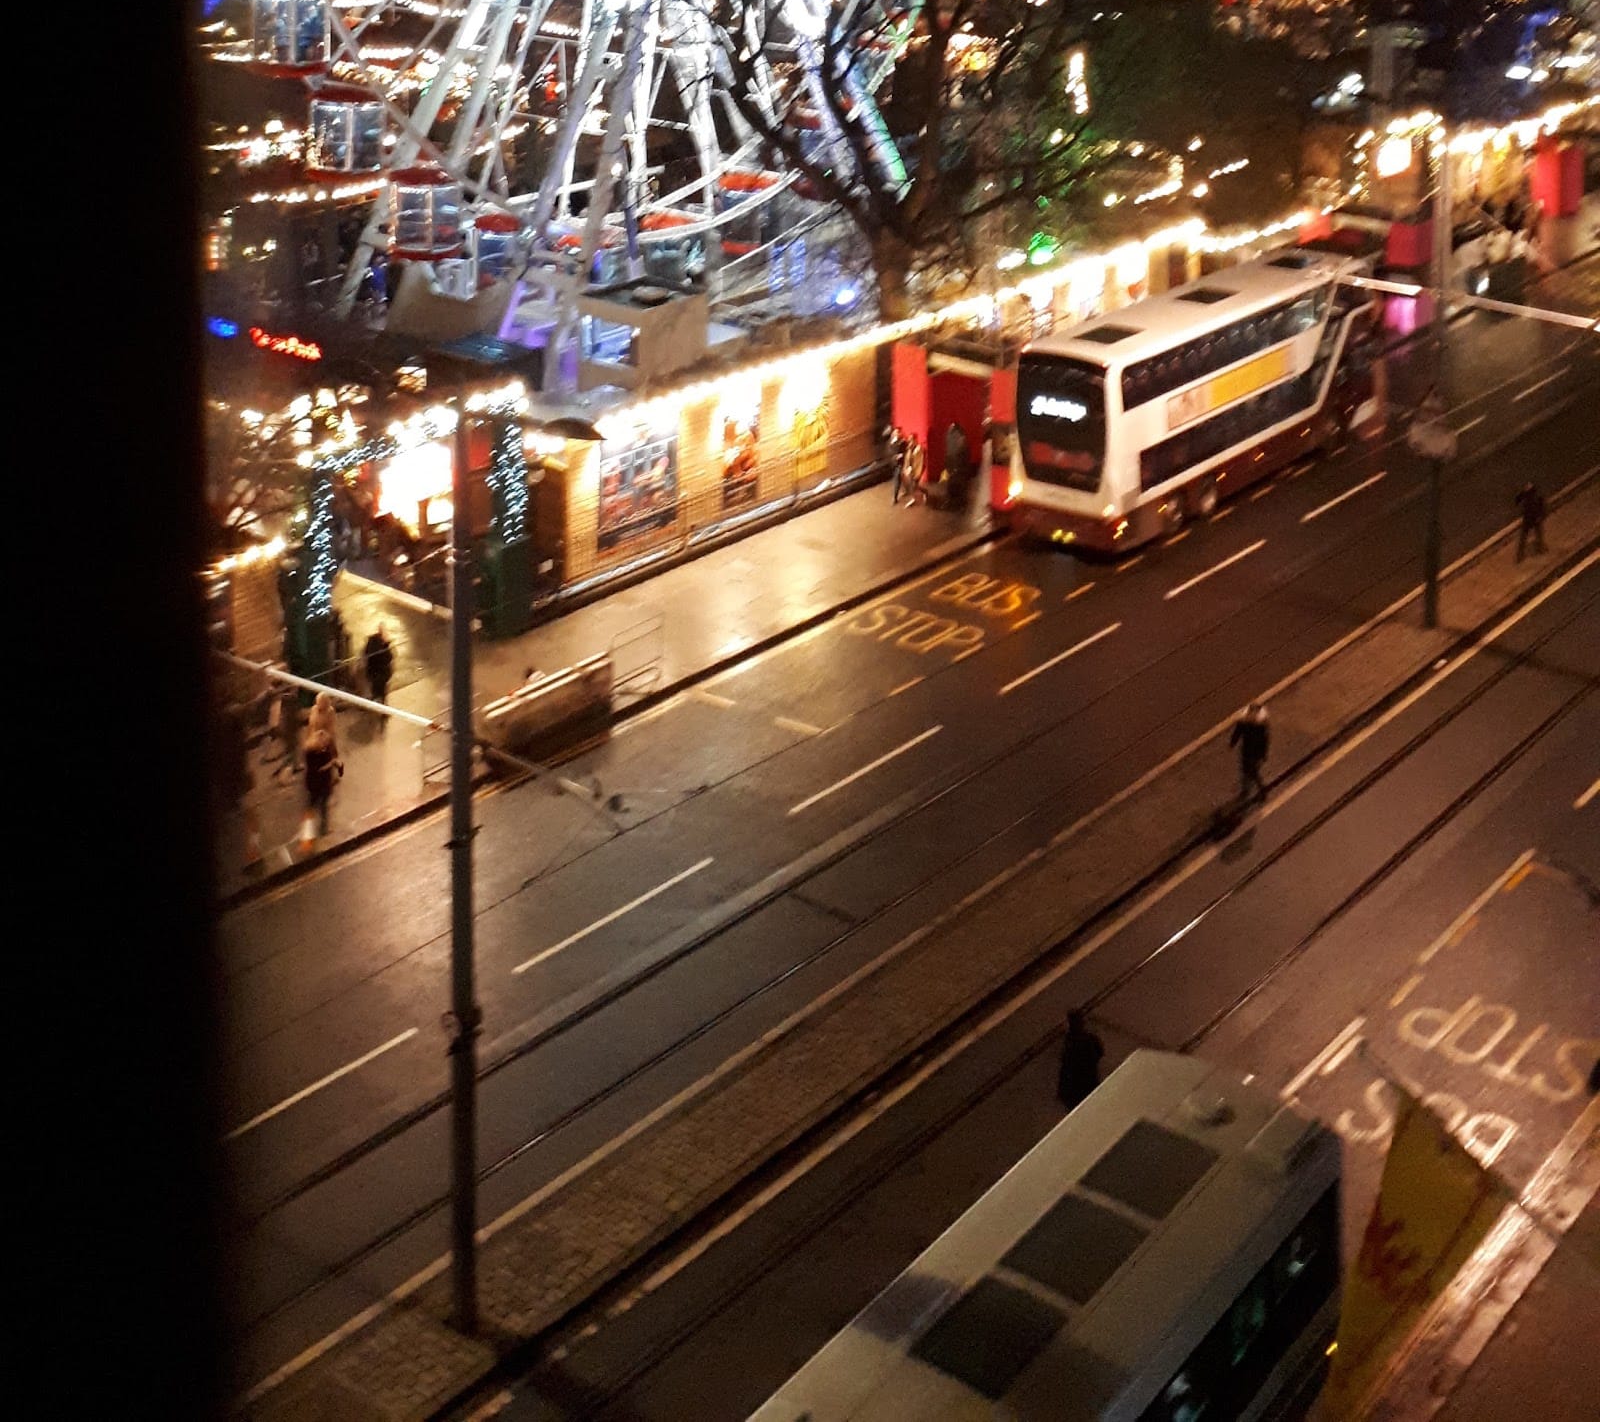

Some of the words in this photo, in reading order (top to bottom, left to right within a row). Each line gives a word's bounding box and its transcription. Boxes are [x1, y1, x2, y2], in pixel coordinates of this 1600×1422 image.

[929, 572, 1042, 615] BUS
[850, 605, 985, 654] STOP
[1399, 995, 1600, 1102] STOP
